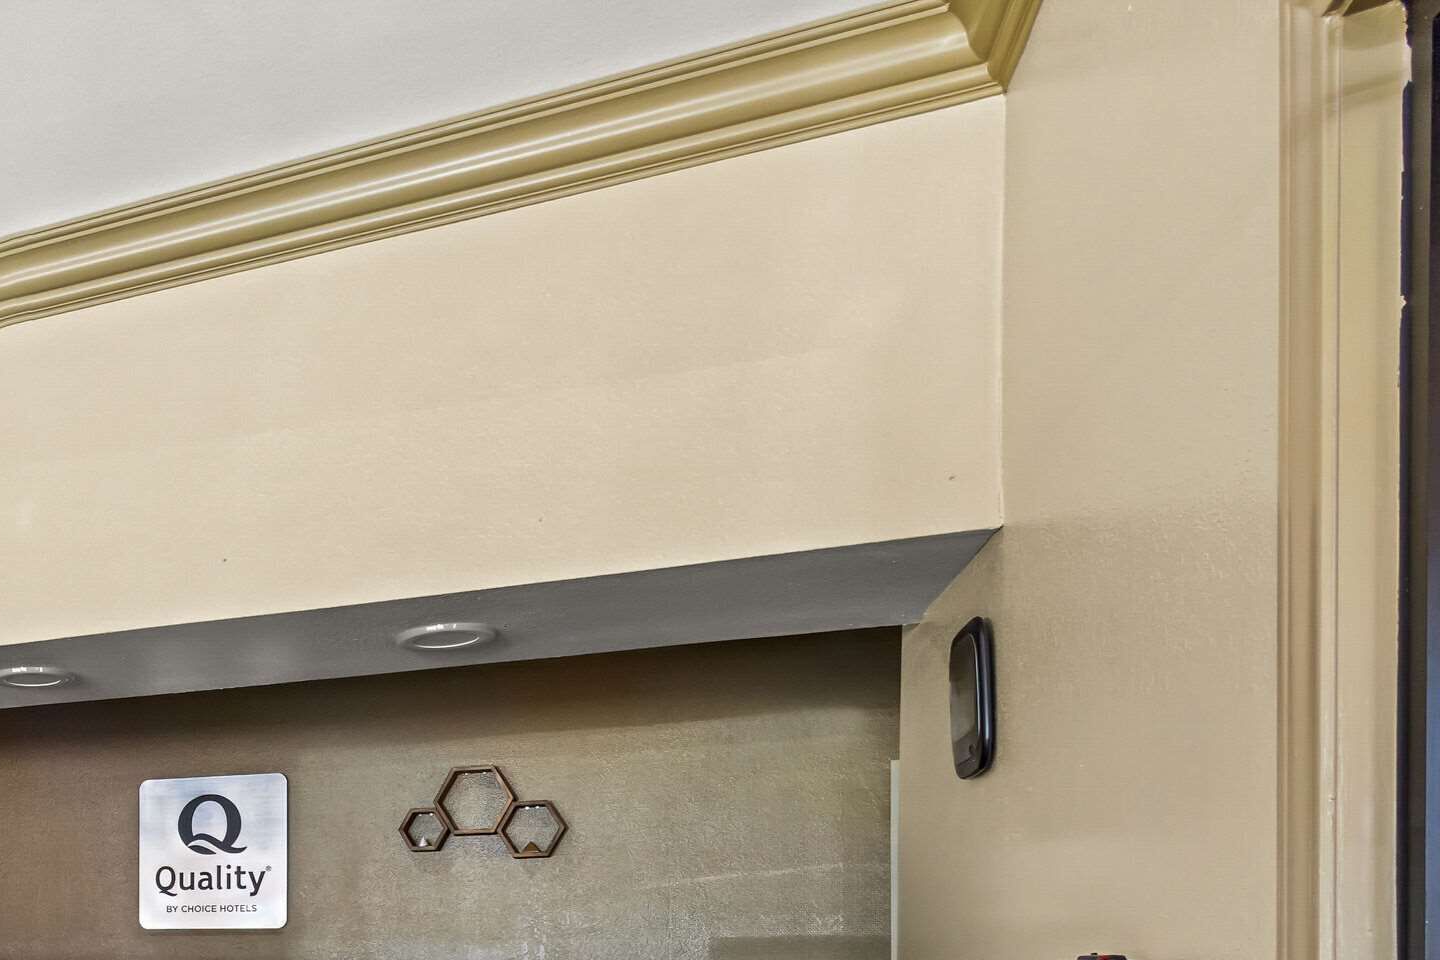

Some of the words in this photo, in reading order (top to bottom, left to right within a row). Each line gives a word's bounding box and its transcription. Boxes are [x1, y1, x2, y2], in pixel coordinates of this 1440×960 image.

[178, 794, 247, 855] Q
[155, 864, 266, 897] Quality
[166, 905, 178, 913] BY
[181, 904, 217, 913] CHOICE
[220, 904, 257, 912] HOTELS
